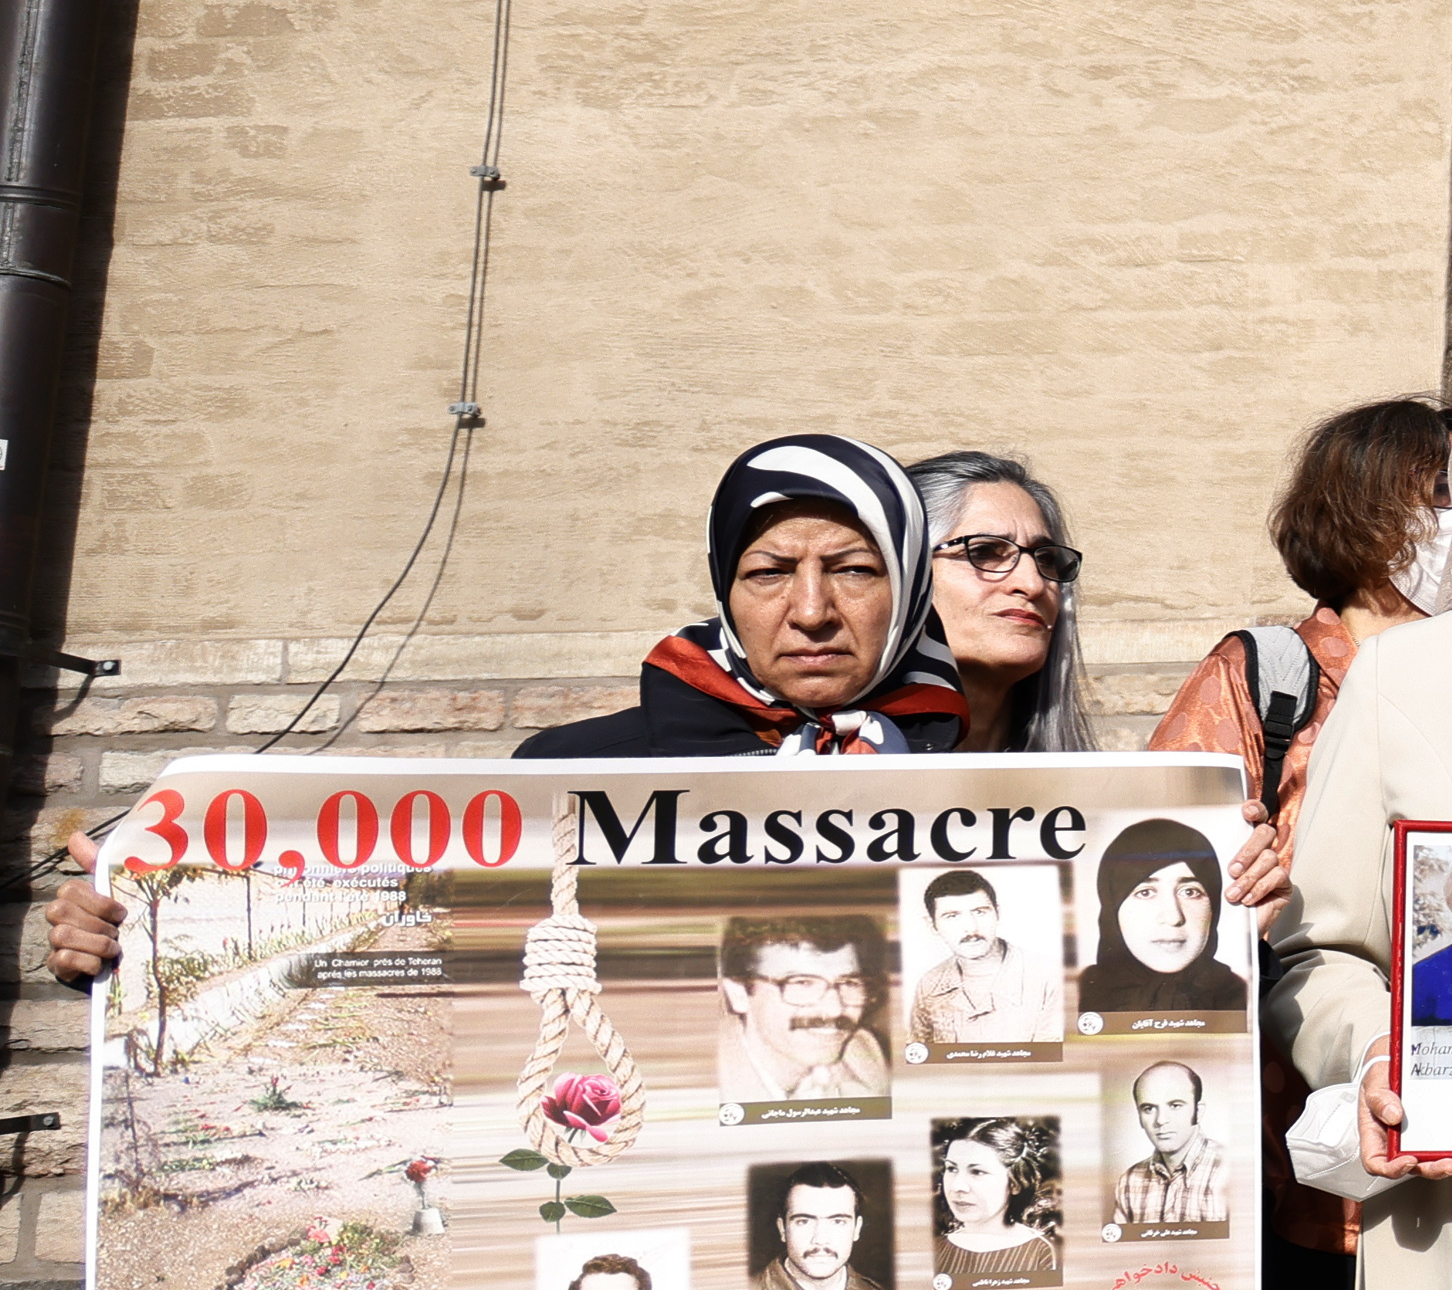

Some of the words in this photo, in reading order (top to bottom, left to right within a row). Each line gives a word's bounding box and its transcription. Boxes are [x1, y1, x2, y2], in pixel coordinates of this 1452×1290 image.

[124, 788, 523, 888] 30,000
[565, 788, 1087, 867] Massacre
[375, 890, 407, 903] 1988
[380, 909, 433, 927] خاوران
